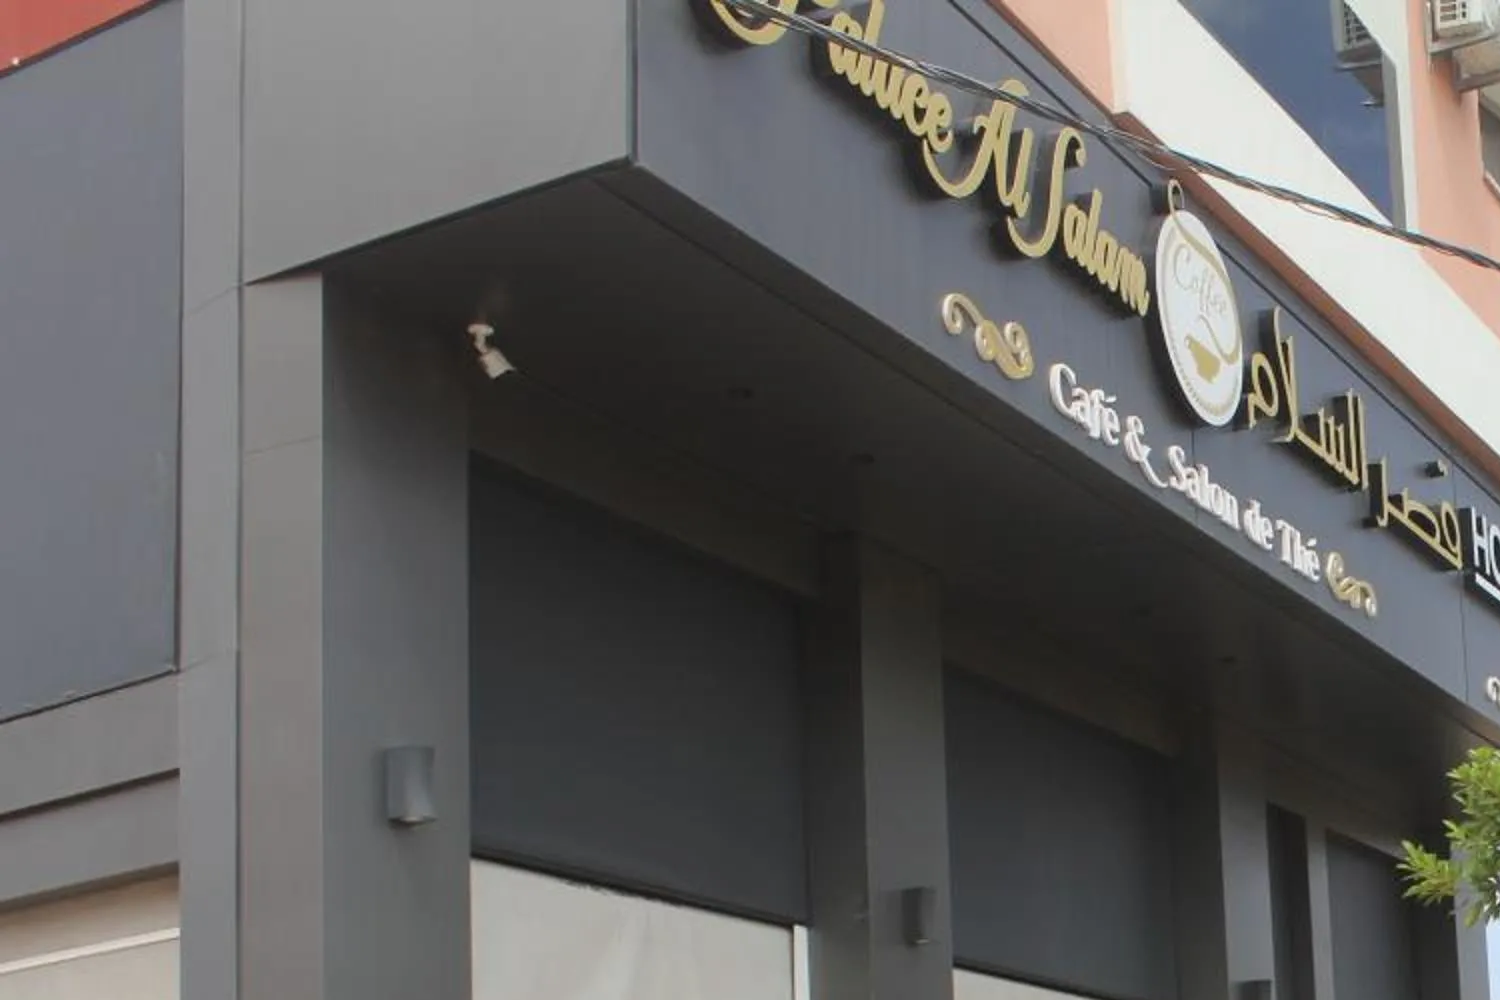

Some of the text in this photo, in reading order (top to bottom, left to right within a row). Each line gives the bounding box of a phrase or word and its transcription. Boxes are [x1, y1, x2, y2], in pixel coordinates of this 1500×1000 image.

[1006, 126, 1150, 316] Salam
[1049, 362, 1321, 583] Café & Salon de Thé
[1246, 305, 1464, 569] قصر السلام
